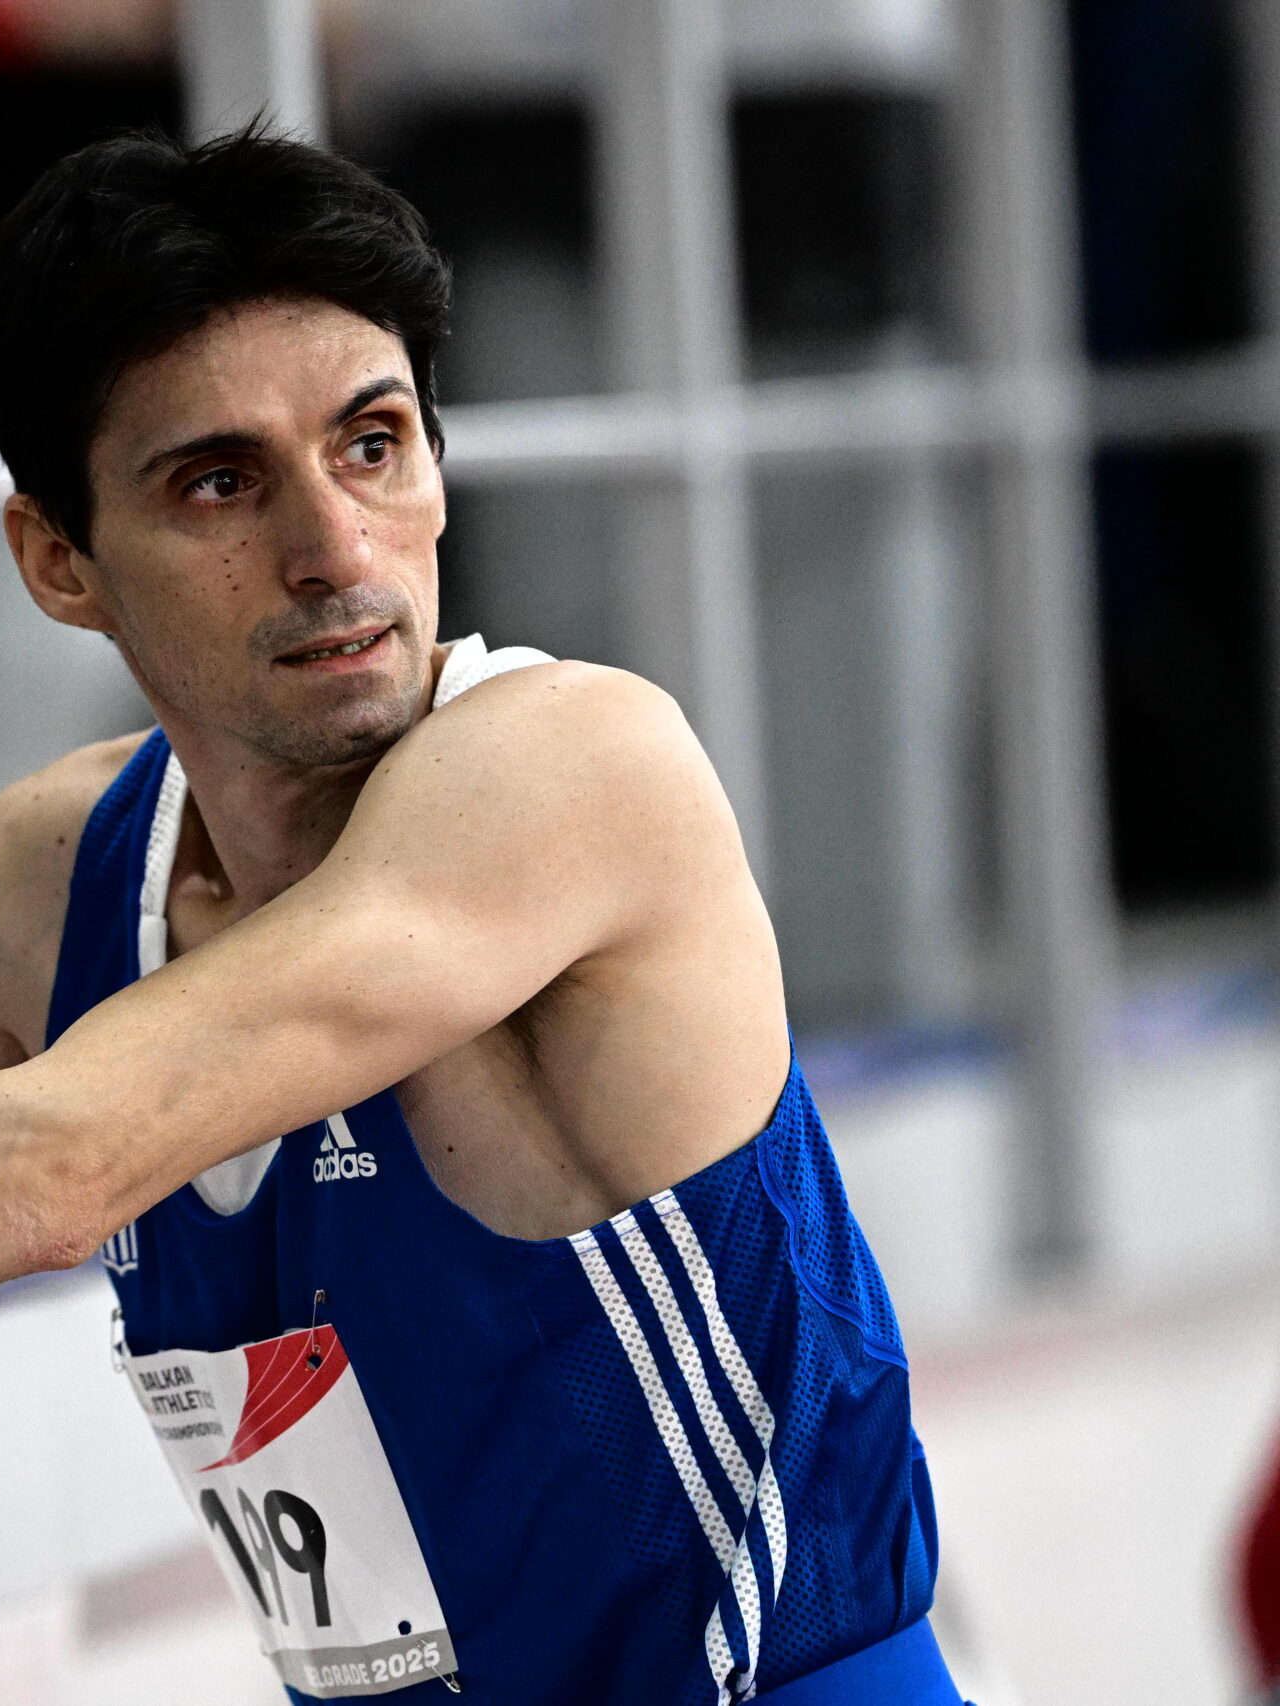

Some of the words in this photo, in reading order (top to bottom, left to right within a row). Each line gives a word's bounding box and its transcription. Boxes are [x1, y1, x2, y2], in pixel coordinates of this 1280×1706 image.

[139, 1365, 195, 1392] BALKAN
[200, 1486, 332, 1628] 199
[371, 1641, 441, 1684] 2025
